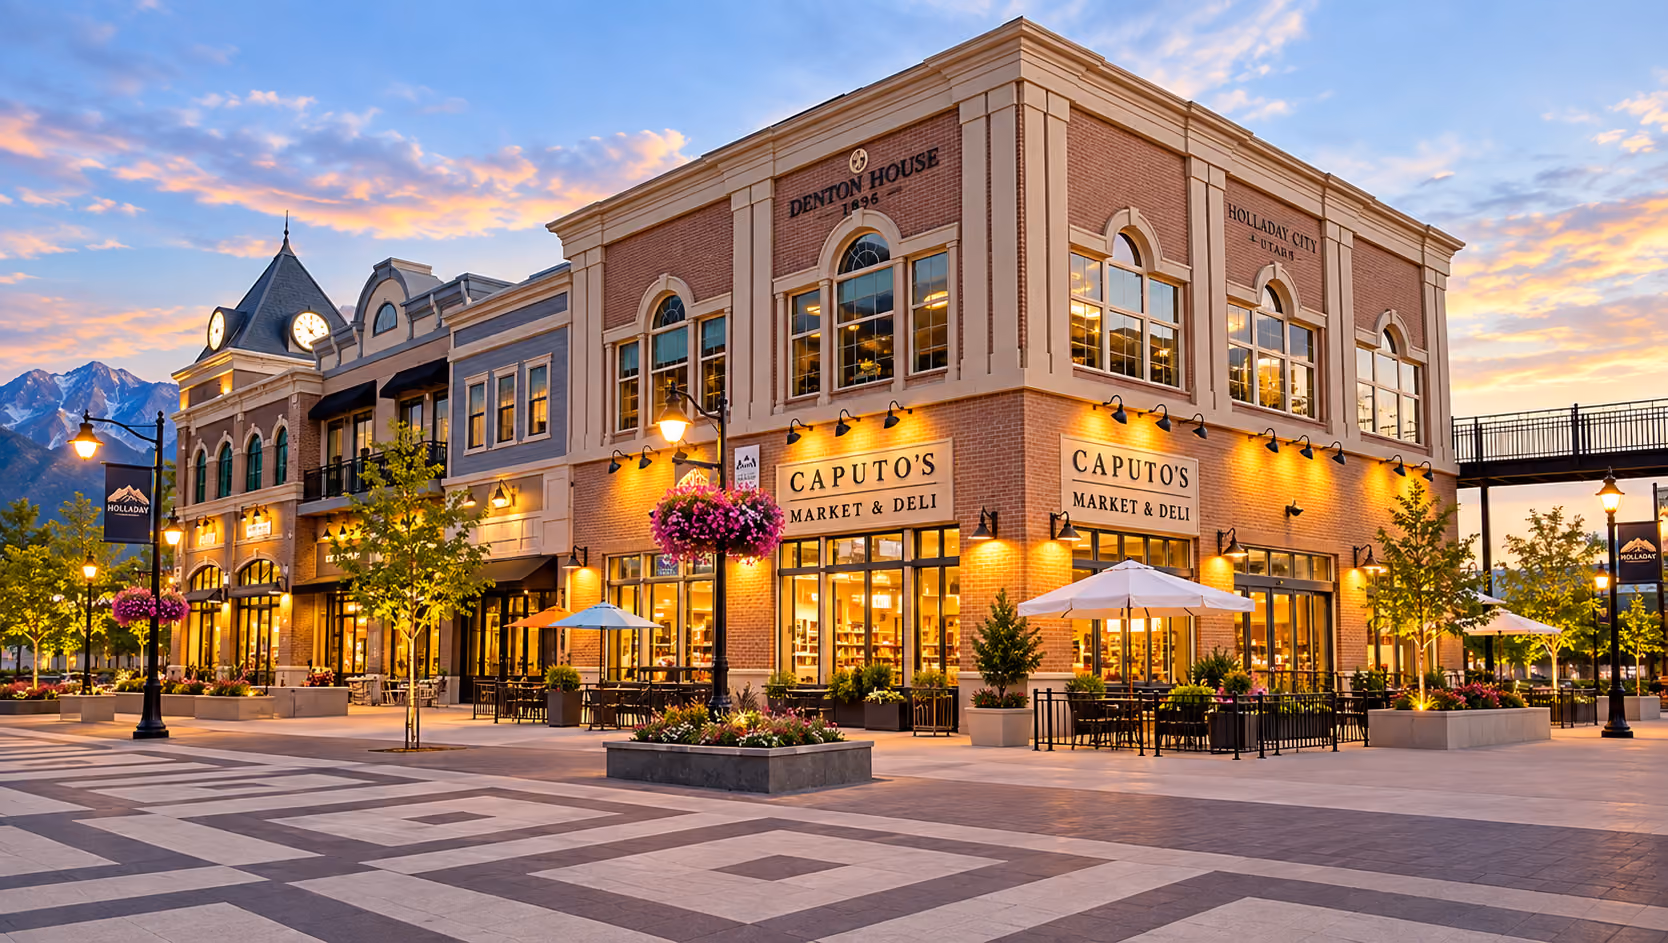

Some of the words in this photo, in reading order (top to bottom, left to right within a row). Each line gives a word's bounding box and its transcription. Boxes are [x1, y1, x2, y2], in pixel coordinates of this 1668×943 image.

[789, 173, 863, 218] DENTON
[868, 147, 940, 190] HOUSE
[841, 192, 879, 217] 1896
[1228, 203, 1289, 241] HOLLADAY
[1292, 231, 1317, 254] CITY
[790, 453, 936, 493] CAPUTO'S
[1073, 449, 1189, 488] CAPUTO'S
[107, 504, 149, 514] HOLLADAY
[790, 502, 863, 524] MARKET
[872, 500, 883, 515] &
[893, 493, 937, 513] DELI
[1073, 491, 1138, 515] MARKET
[1144, 501, 1153, 517] &
[1159, 503, 1190, 521] DELI
[1621, 553, 1657, 561] HOLLADAY
